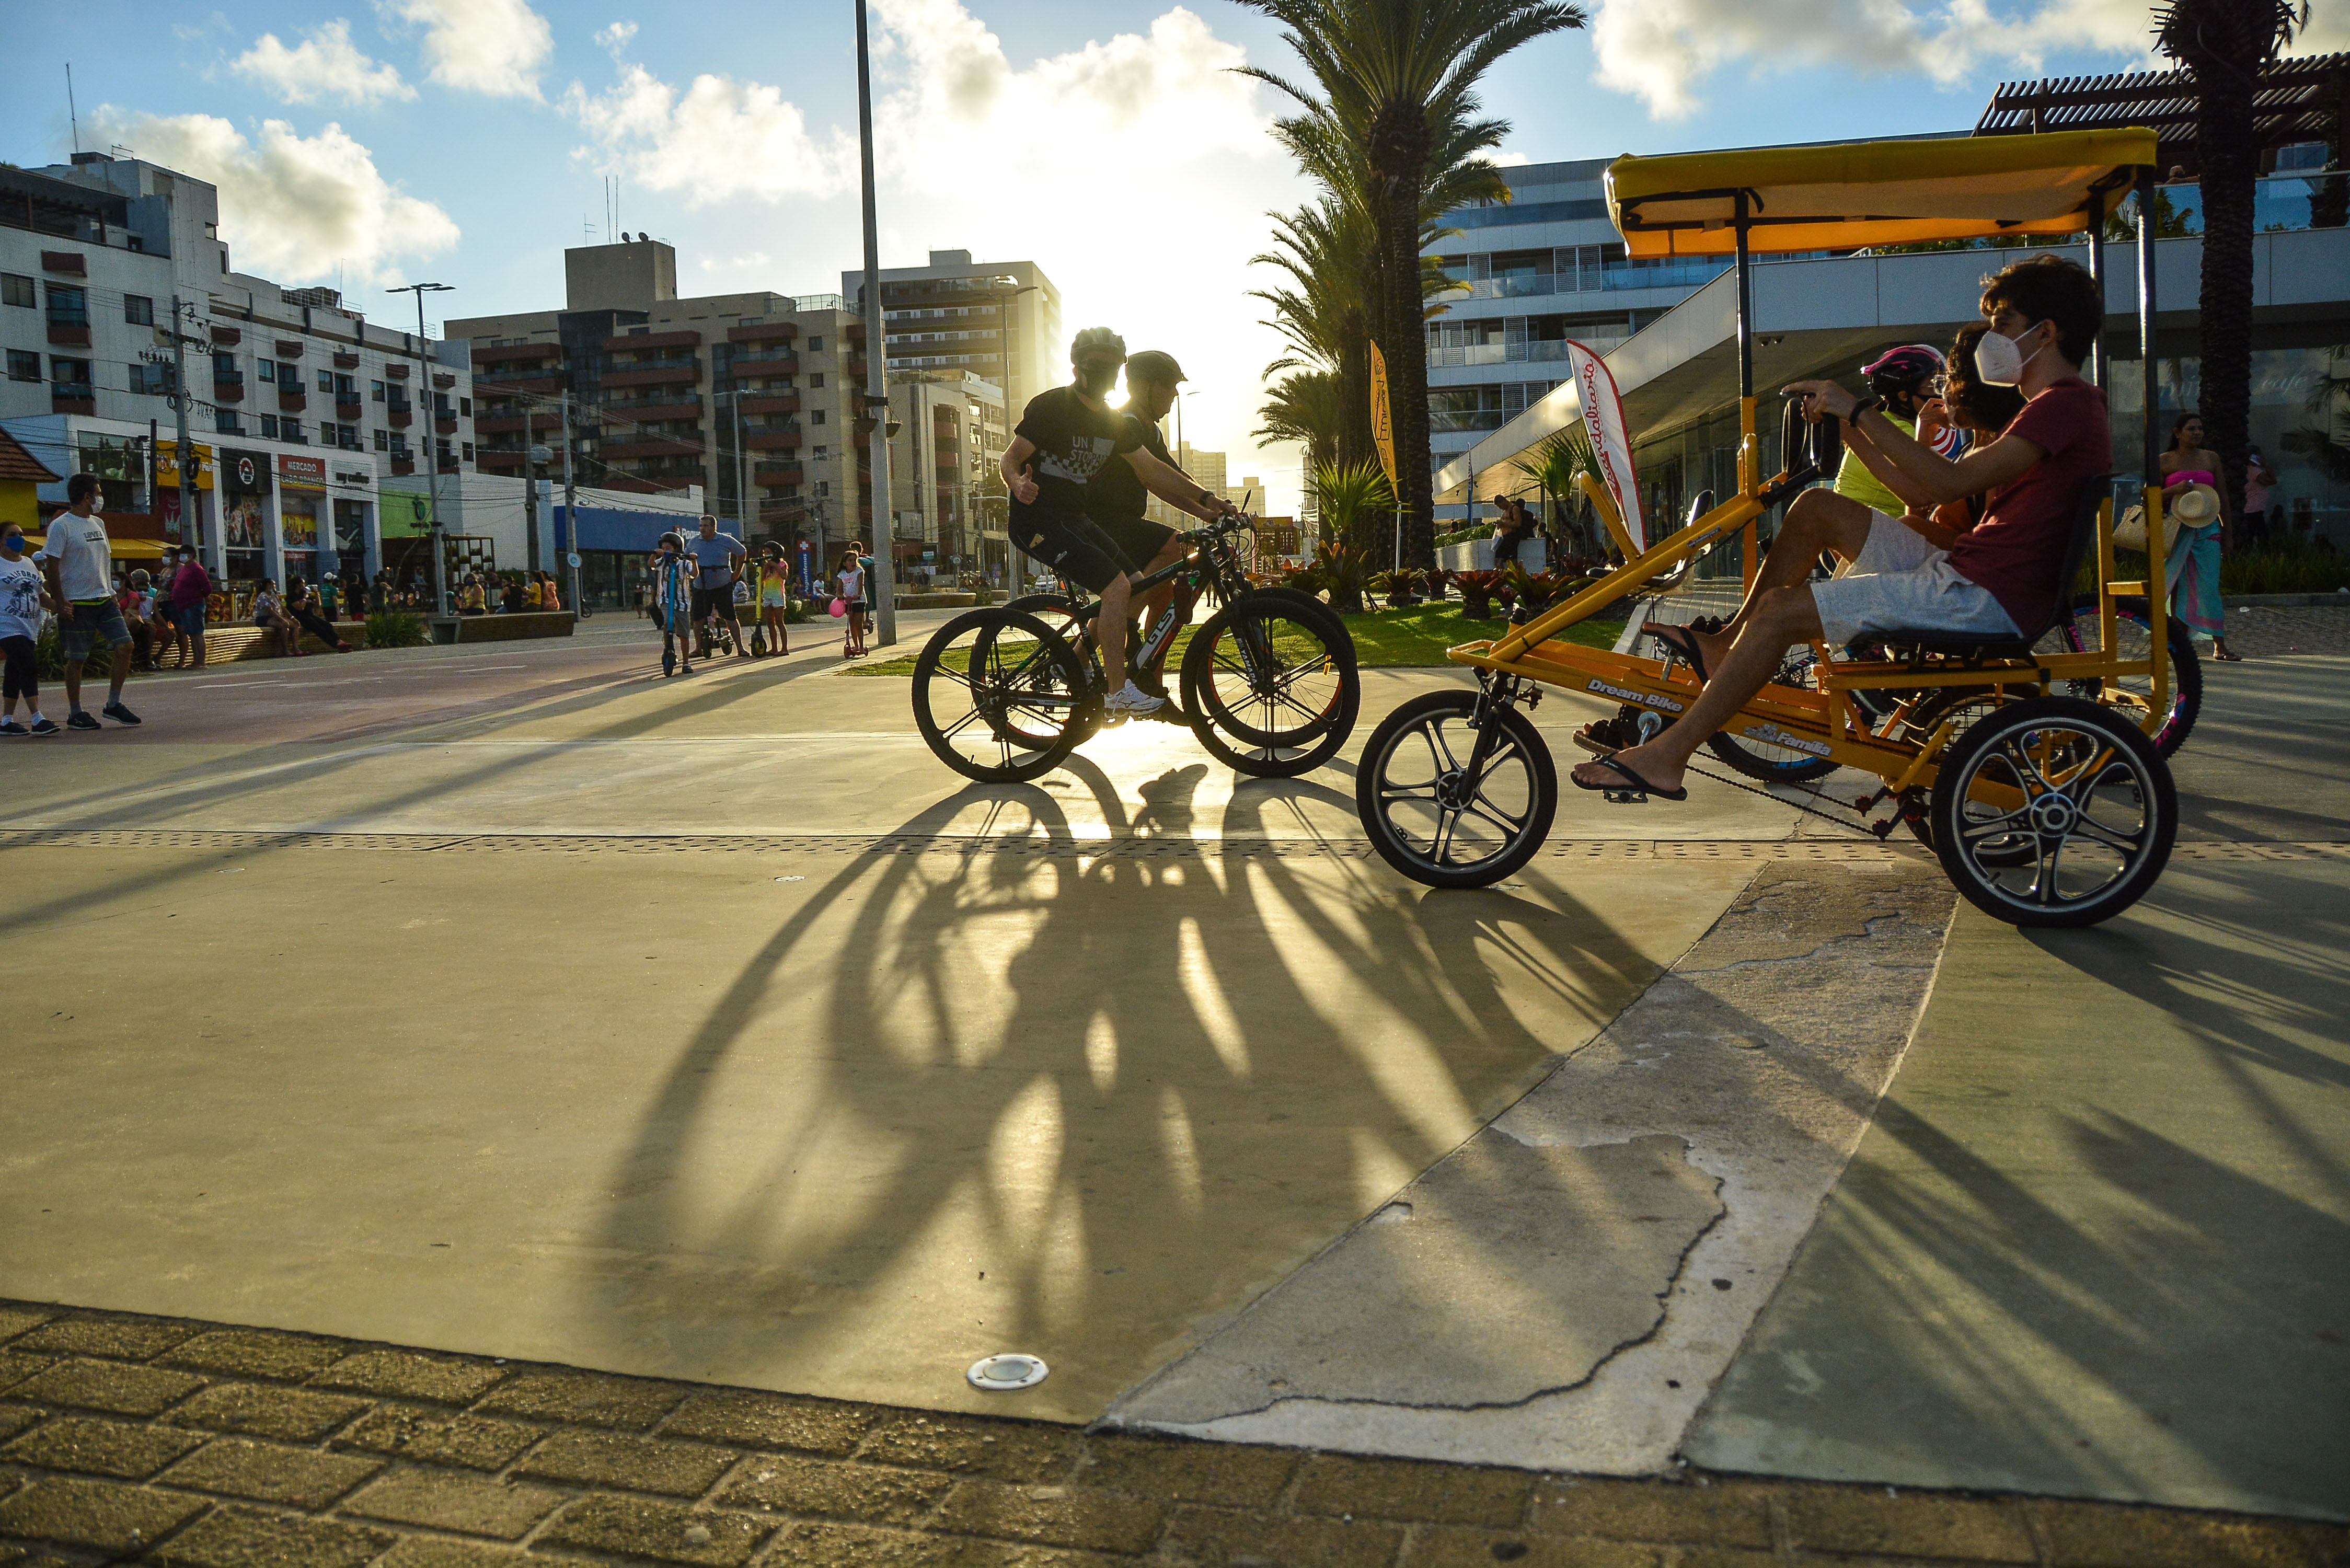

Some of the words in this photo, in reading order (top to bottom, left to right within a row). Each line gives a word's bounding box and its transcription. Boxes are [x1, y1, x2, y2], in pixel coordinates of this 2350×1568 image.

[287, 460, 316, 472] MERCADO
[281, 474, 298, 483] CABO
[299, 475, 324, 486] BRANCO
[2, 570, 43, 586] CALIFORNIA
[4, 605, 19, 615] LOS
[1241, 649, 1258, 684] YAMADA
[1587, 678, 1644, 703] Dream
[1644, 693, 1683, 712] Bike
